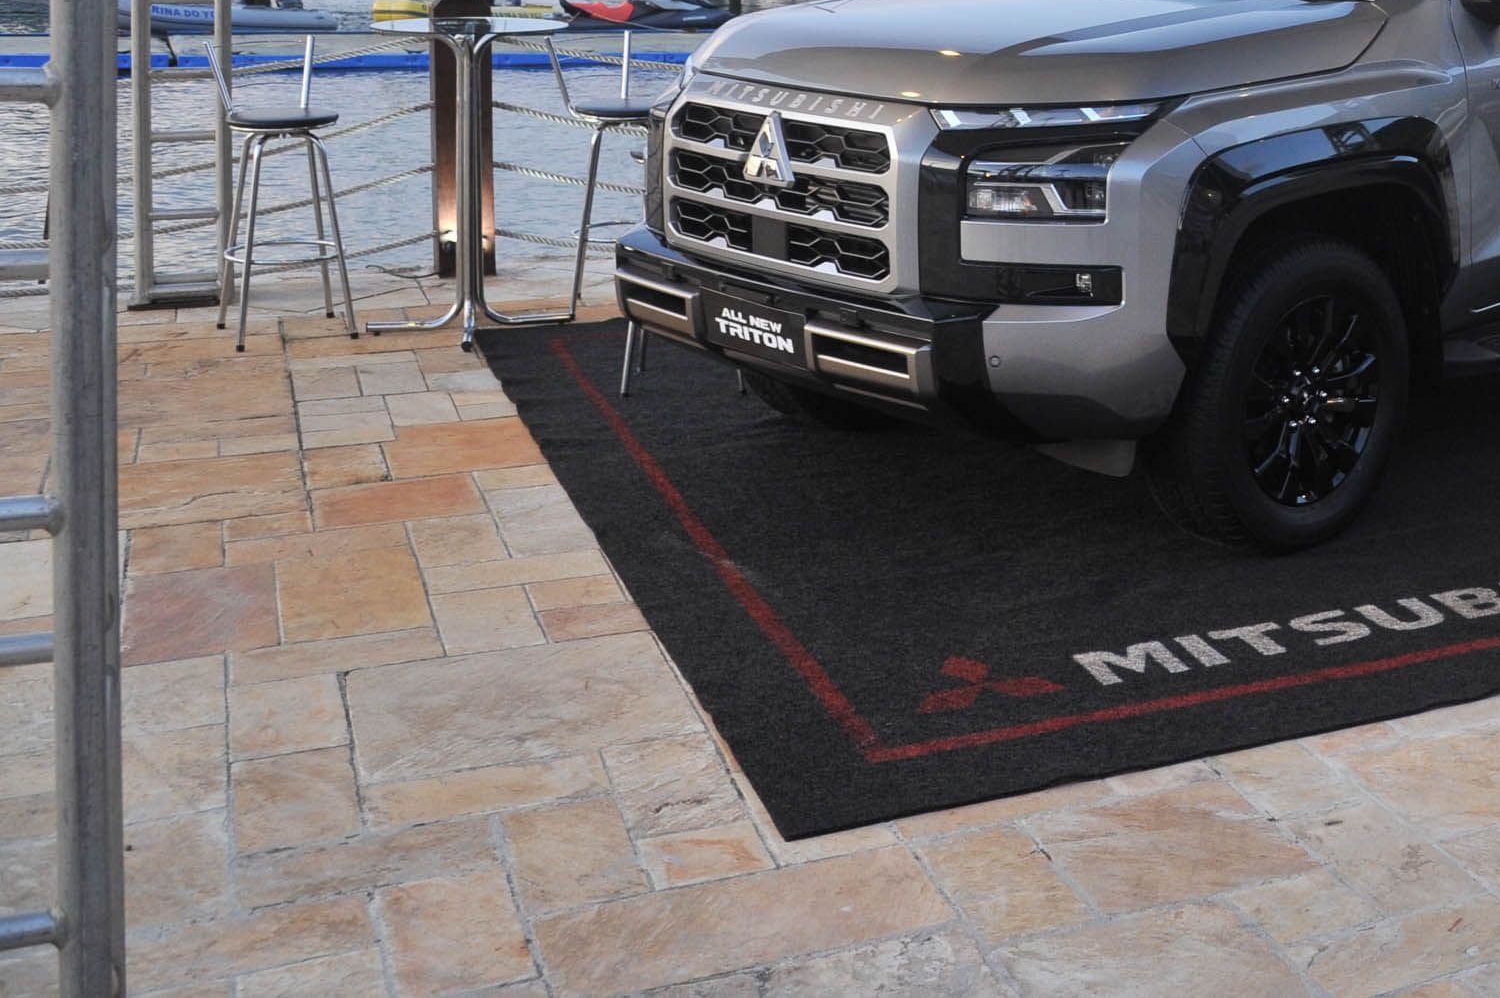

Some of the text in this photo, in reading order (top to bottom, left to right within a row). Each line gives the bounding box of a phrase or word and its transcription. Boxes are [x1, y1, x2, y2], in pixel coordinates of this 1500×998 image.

[706, 80, 886, 120] MITSUBISHI
[714, 317, 794, 354] TRITON
[721, 307, 782, 334] ALL NEW
